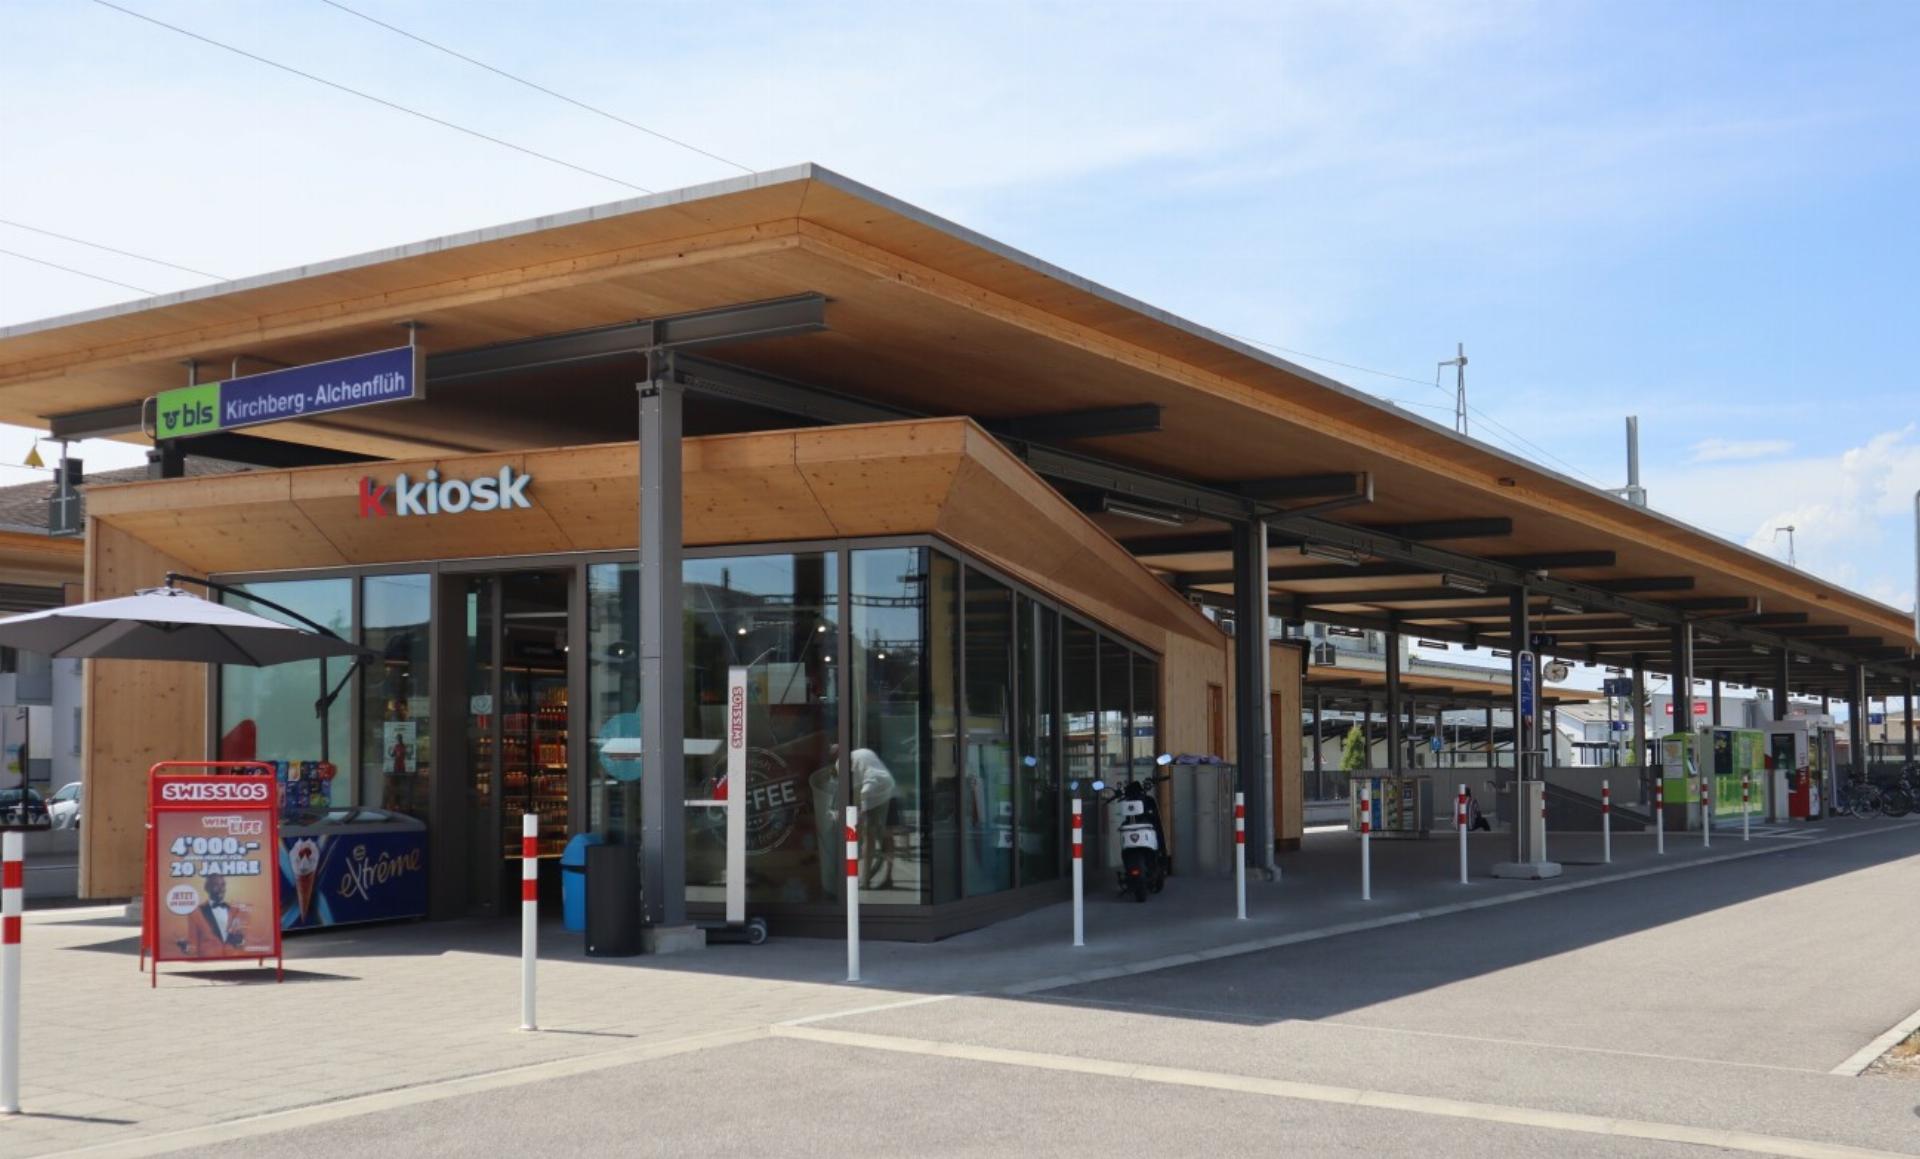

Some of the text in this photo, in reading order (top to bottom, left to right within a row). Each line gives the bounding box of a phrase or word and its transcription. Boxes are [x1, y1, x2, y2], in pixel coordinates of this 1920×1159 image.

[226, 393, 304, 421] Kirchberg
[315, 371, 405, 405] Alchenflüh
[182, 400, 214, 427] bls
[396, 464, 532, 517] kiosk
[731, 687, 744, 749] SWISSLOS
[162, 783, 268, 801] SWISSLOS
[230, 821, 261, 834] LIFE
[170, 836, 260, 856] 4'000.-
[170, 860, 261, 877] 20 JAHRE
